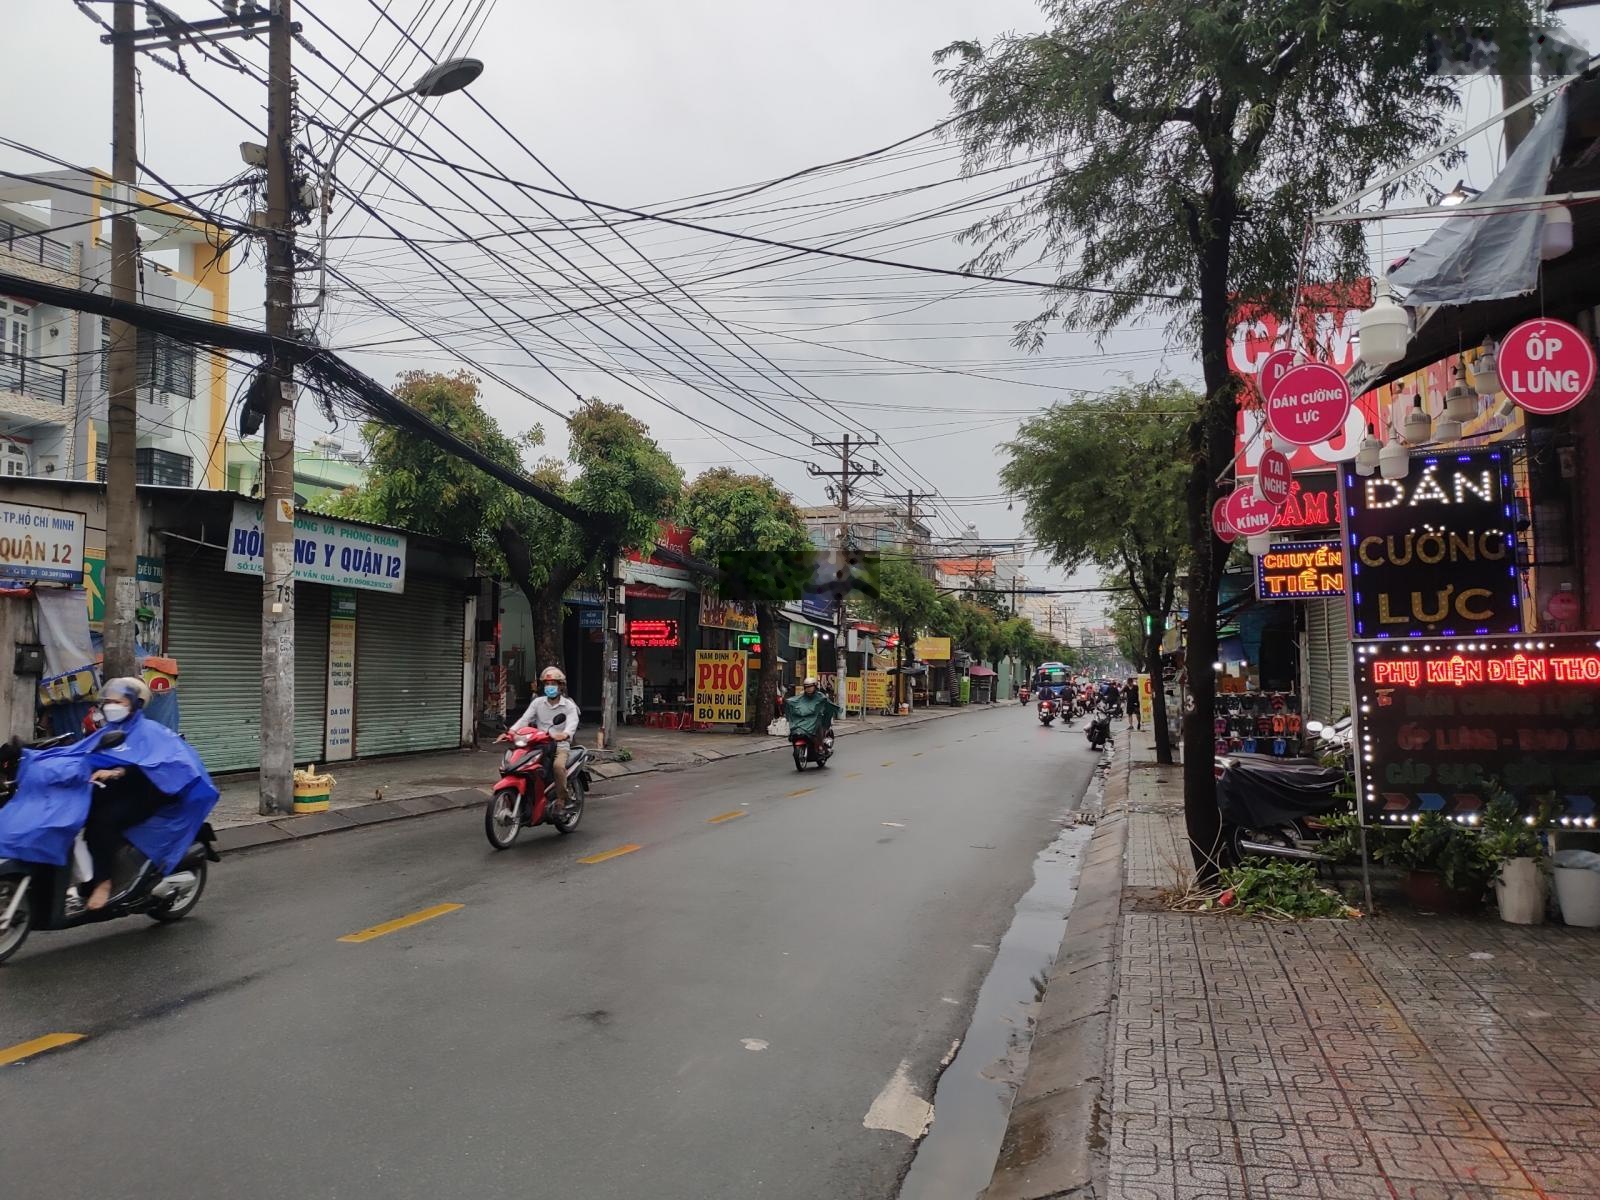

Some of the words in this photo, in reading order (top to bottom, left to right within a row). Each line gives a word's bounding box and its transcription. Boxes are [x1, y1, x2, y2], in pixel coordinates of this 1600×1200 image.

[1526, 329, 1563, 361] ỐP
[1512, 366, 1580, 393] LƯNG
[1273, 394, 1298, 409] DÁN
[1301, 388, 1343, 405] CƯỜNG
[1295, 410, 1320, 425] LỰC
[1268, 459, 1284, 476] TAI
[1264, 477, 1288, 496] NGHE
[1365, 464, 1492, 510] DÁN
[52, 516, 75, 532] MINH
[1236, 513, 1270, 530] KÍNH
[340, 527, 372, 542] PHÒNG
[1358, 523, 1506, 568] CƯỜNG
[51, 543, 73, 565] 12
[324, 543, 337, 568] Y
[341, 547, 383, 578] QUẬN
[385, 554, 402, 579] 12
[1263, 546, 1343, 569] CHUYỂN
[1264, 568, 1344, 593] TIỀN
[1377, 584, 1495, 631] LỰC
[699, 653, 713, 661] NAM
[714, 652, 730, 662] ĐỊNH
[698, 652, 745, 690] PHỞ
[1374, 660, 1420, 687] PHỤ
[1426, 655, 1483, 686] KIỆN
[1487, 654, 1547, 685] ĐIỆN
[697, 691, 713, 704] BÚN
[715, 690, 726, 705] BÒ
[727, 689, 743, 705] HUẾ
[698, 705, 714, 720] BÒ
[718, 708, 741, 720] KHO
